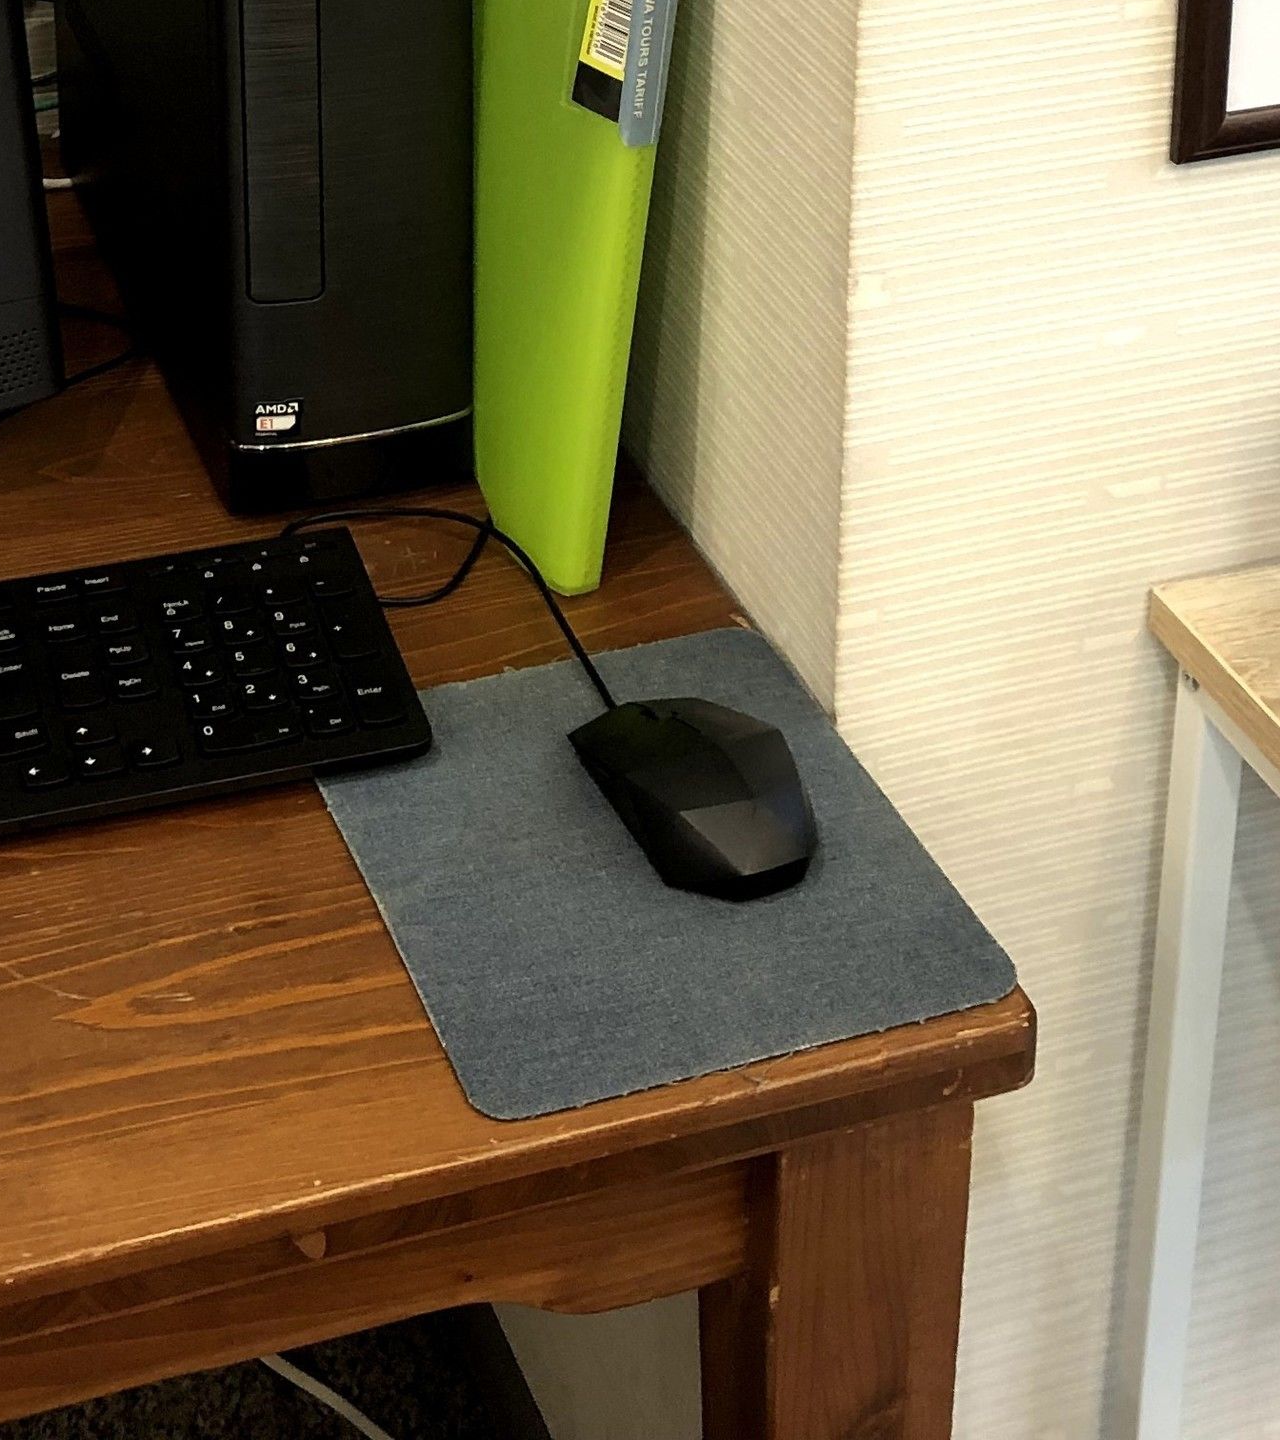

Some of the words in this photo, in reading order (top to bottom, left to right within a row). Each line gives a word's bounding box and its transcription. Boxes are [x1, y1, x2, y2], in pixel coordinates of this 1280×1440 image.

[637, 20, 654, 67] TOURS
[633, 69, 649, 120] TARIFF
[255, 404, 287, 415] AMD
